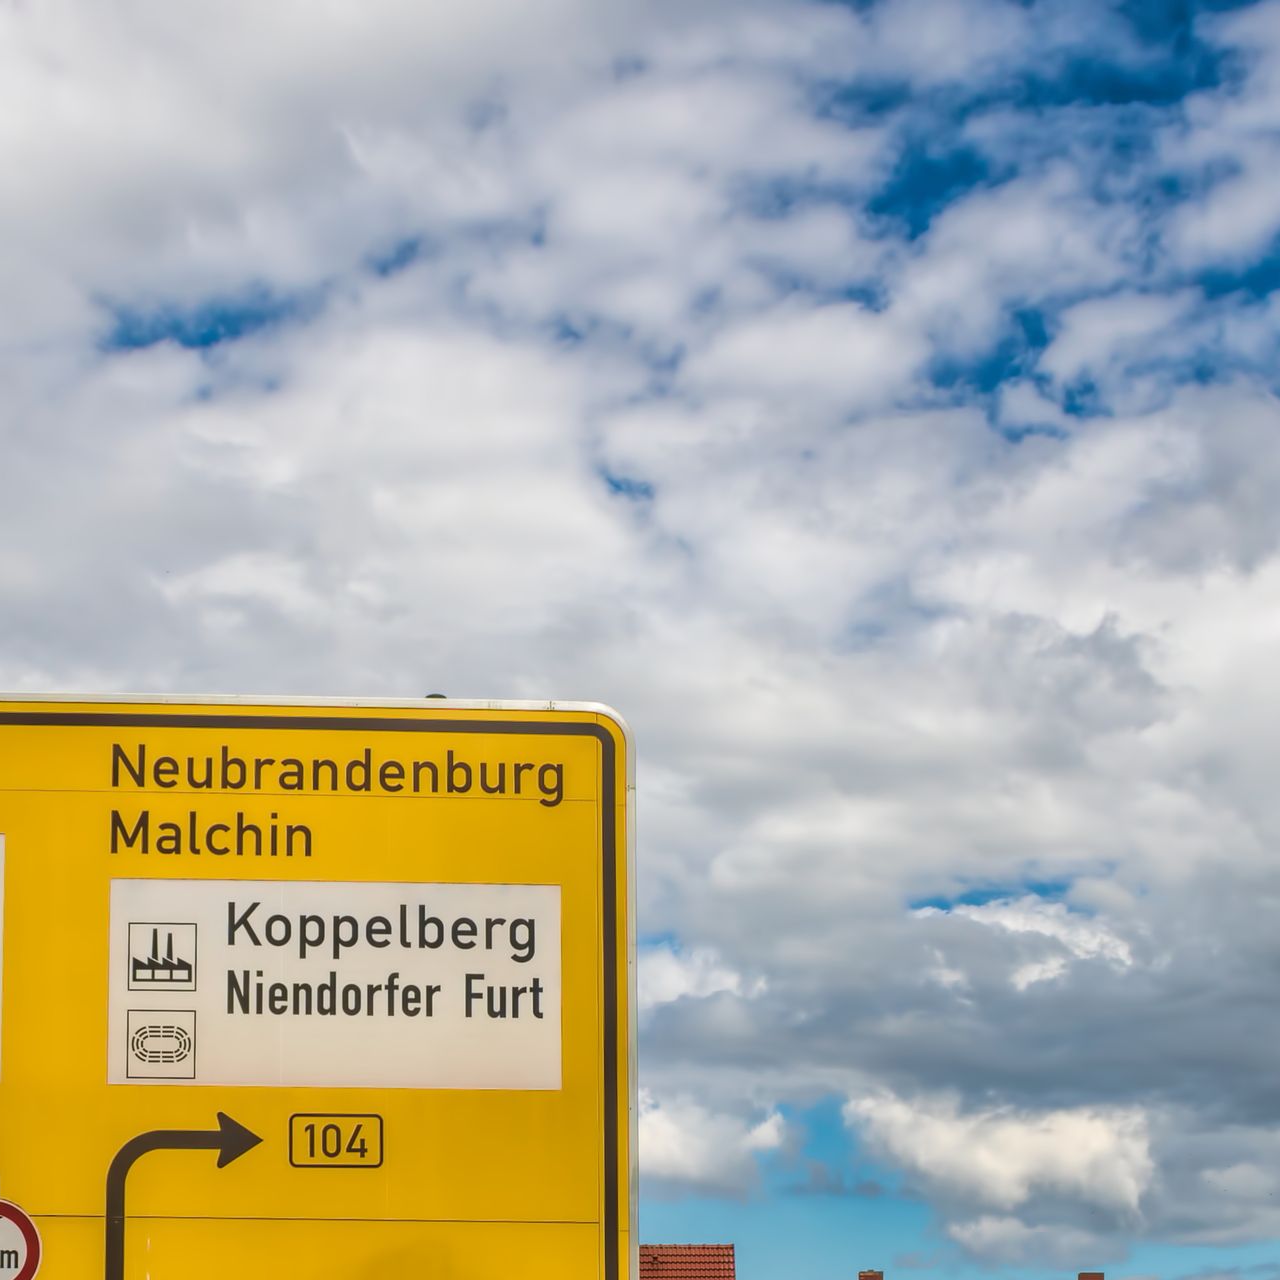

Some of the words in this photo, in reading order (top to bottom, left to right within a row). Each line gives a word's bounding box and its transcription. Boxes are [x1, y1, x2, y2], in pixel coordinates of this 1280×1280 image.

[112, 743, 564, 808] Neubrandenburg
[111, 810, 312, 857] Malchin
[227, 901, 536, 964] Koppelberg
[227, 969, 441, 1017] Niendorfer
[465, 973, 544, 1019] Furt
[304, 1123, 368, 1158] 104
